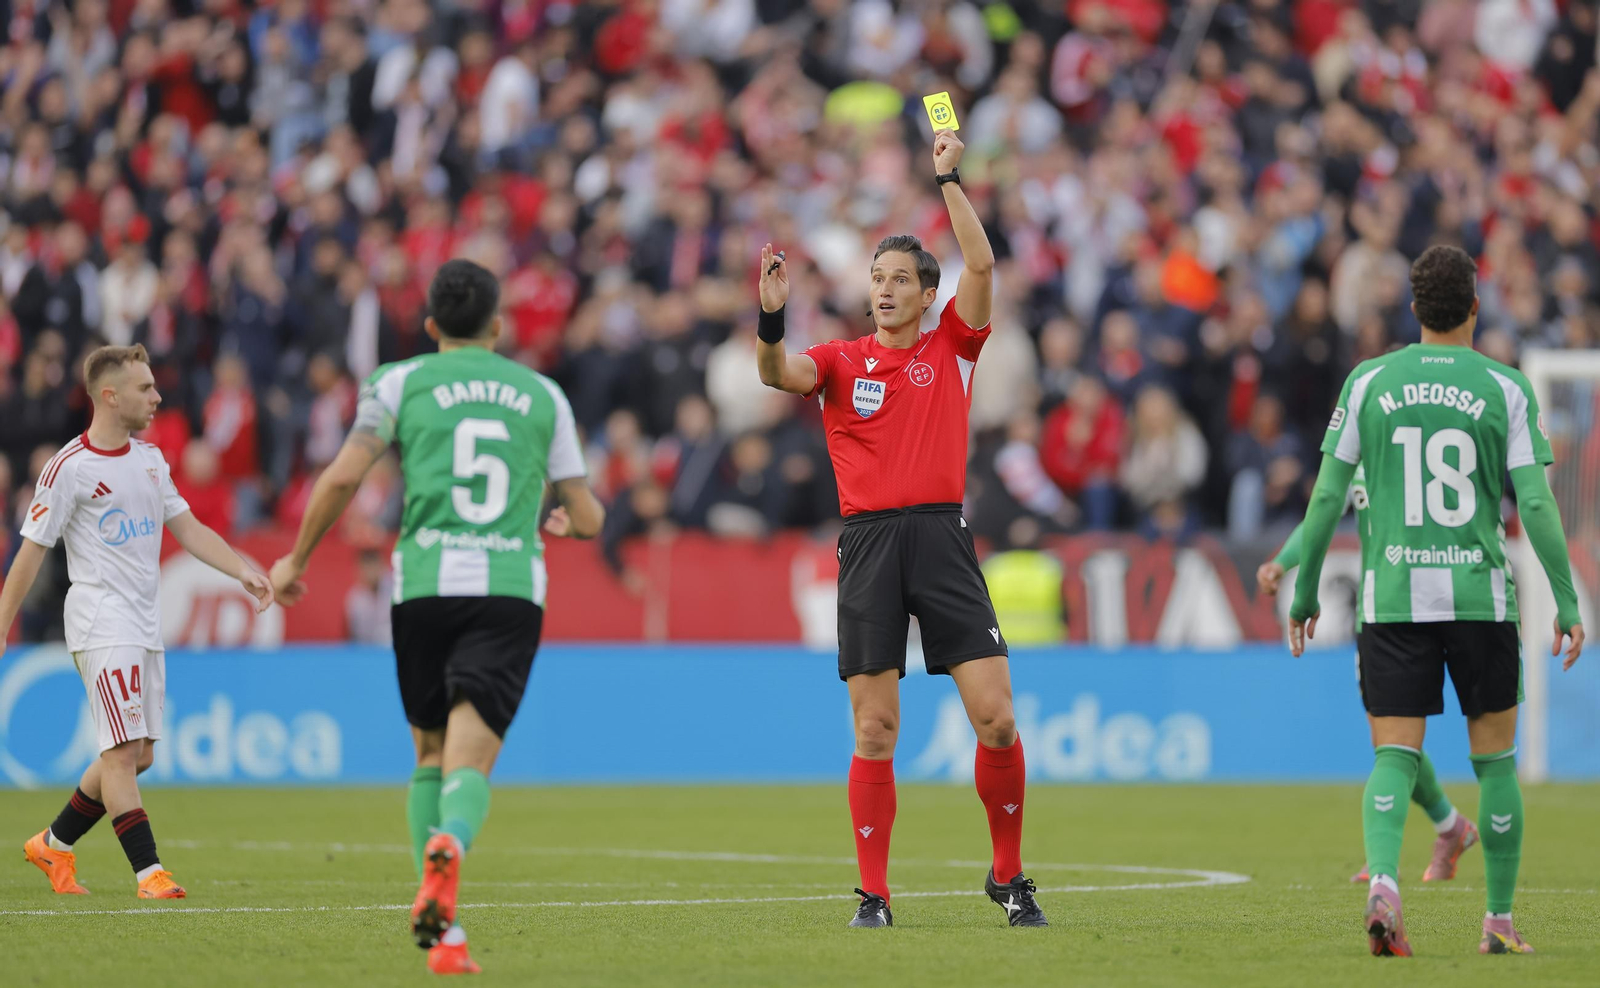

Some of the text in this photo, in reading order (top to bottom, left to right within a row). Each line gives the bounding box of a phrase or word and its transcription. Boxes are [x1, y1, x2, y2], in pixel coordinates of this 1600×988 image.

[914, 366, 927, 376] RF
[1420, 356, 1455, 365] prima
[857, 381, 881, 393] FIFA
[916, 374, 929, 382] EF
[432, 380, 533, 417] BARTRA
[855, 395, 880, 405] REFEREE
[1378, 383, 1486, 421] N. DEOSSA
[451, 417, 511, 525] 5
[1391, 426, 1477, 528] 18
[440, 530, 524, 552] trainline
[1404, 545, 1484, 565] trainline
[111, 665, 141, 702] 14
